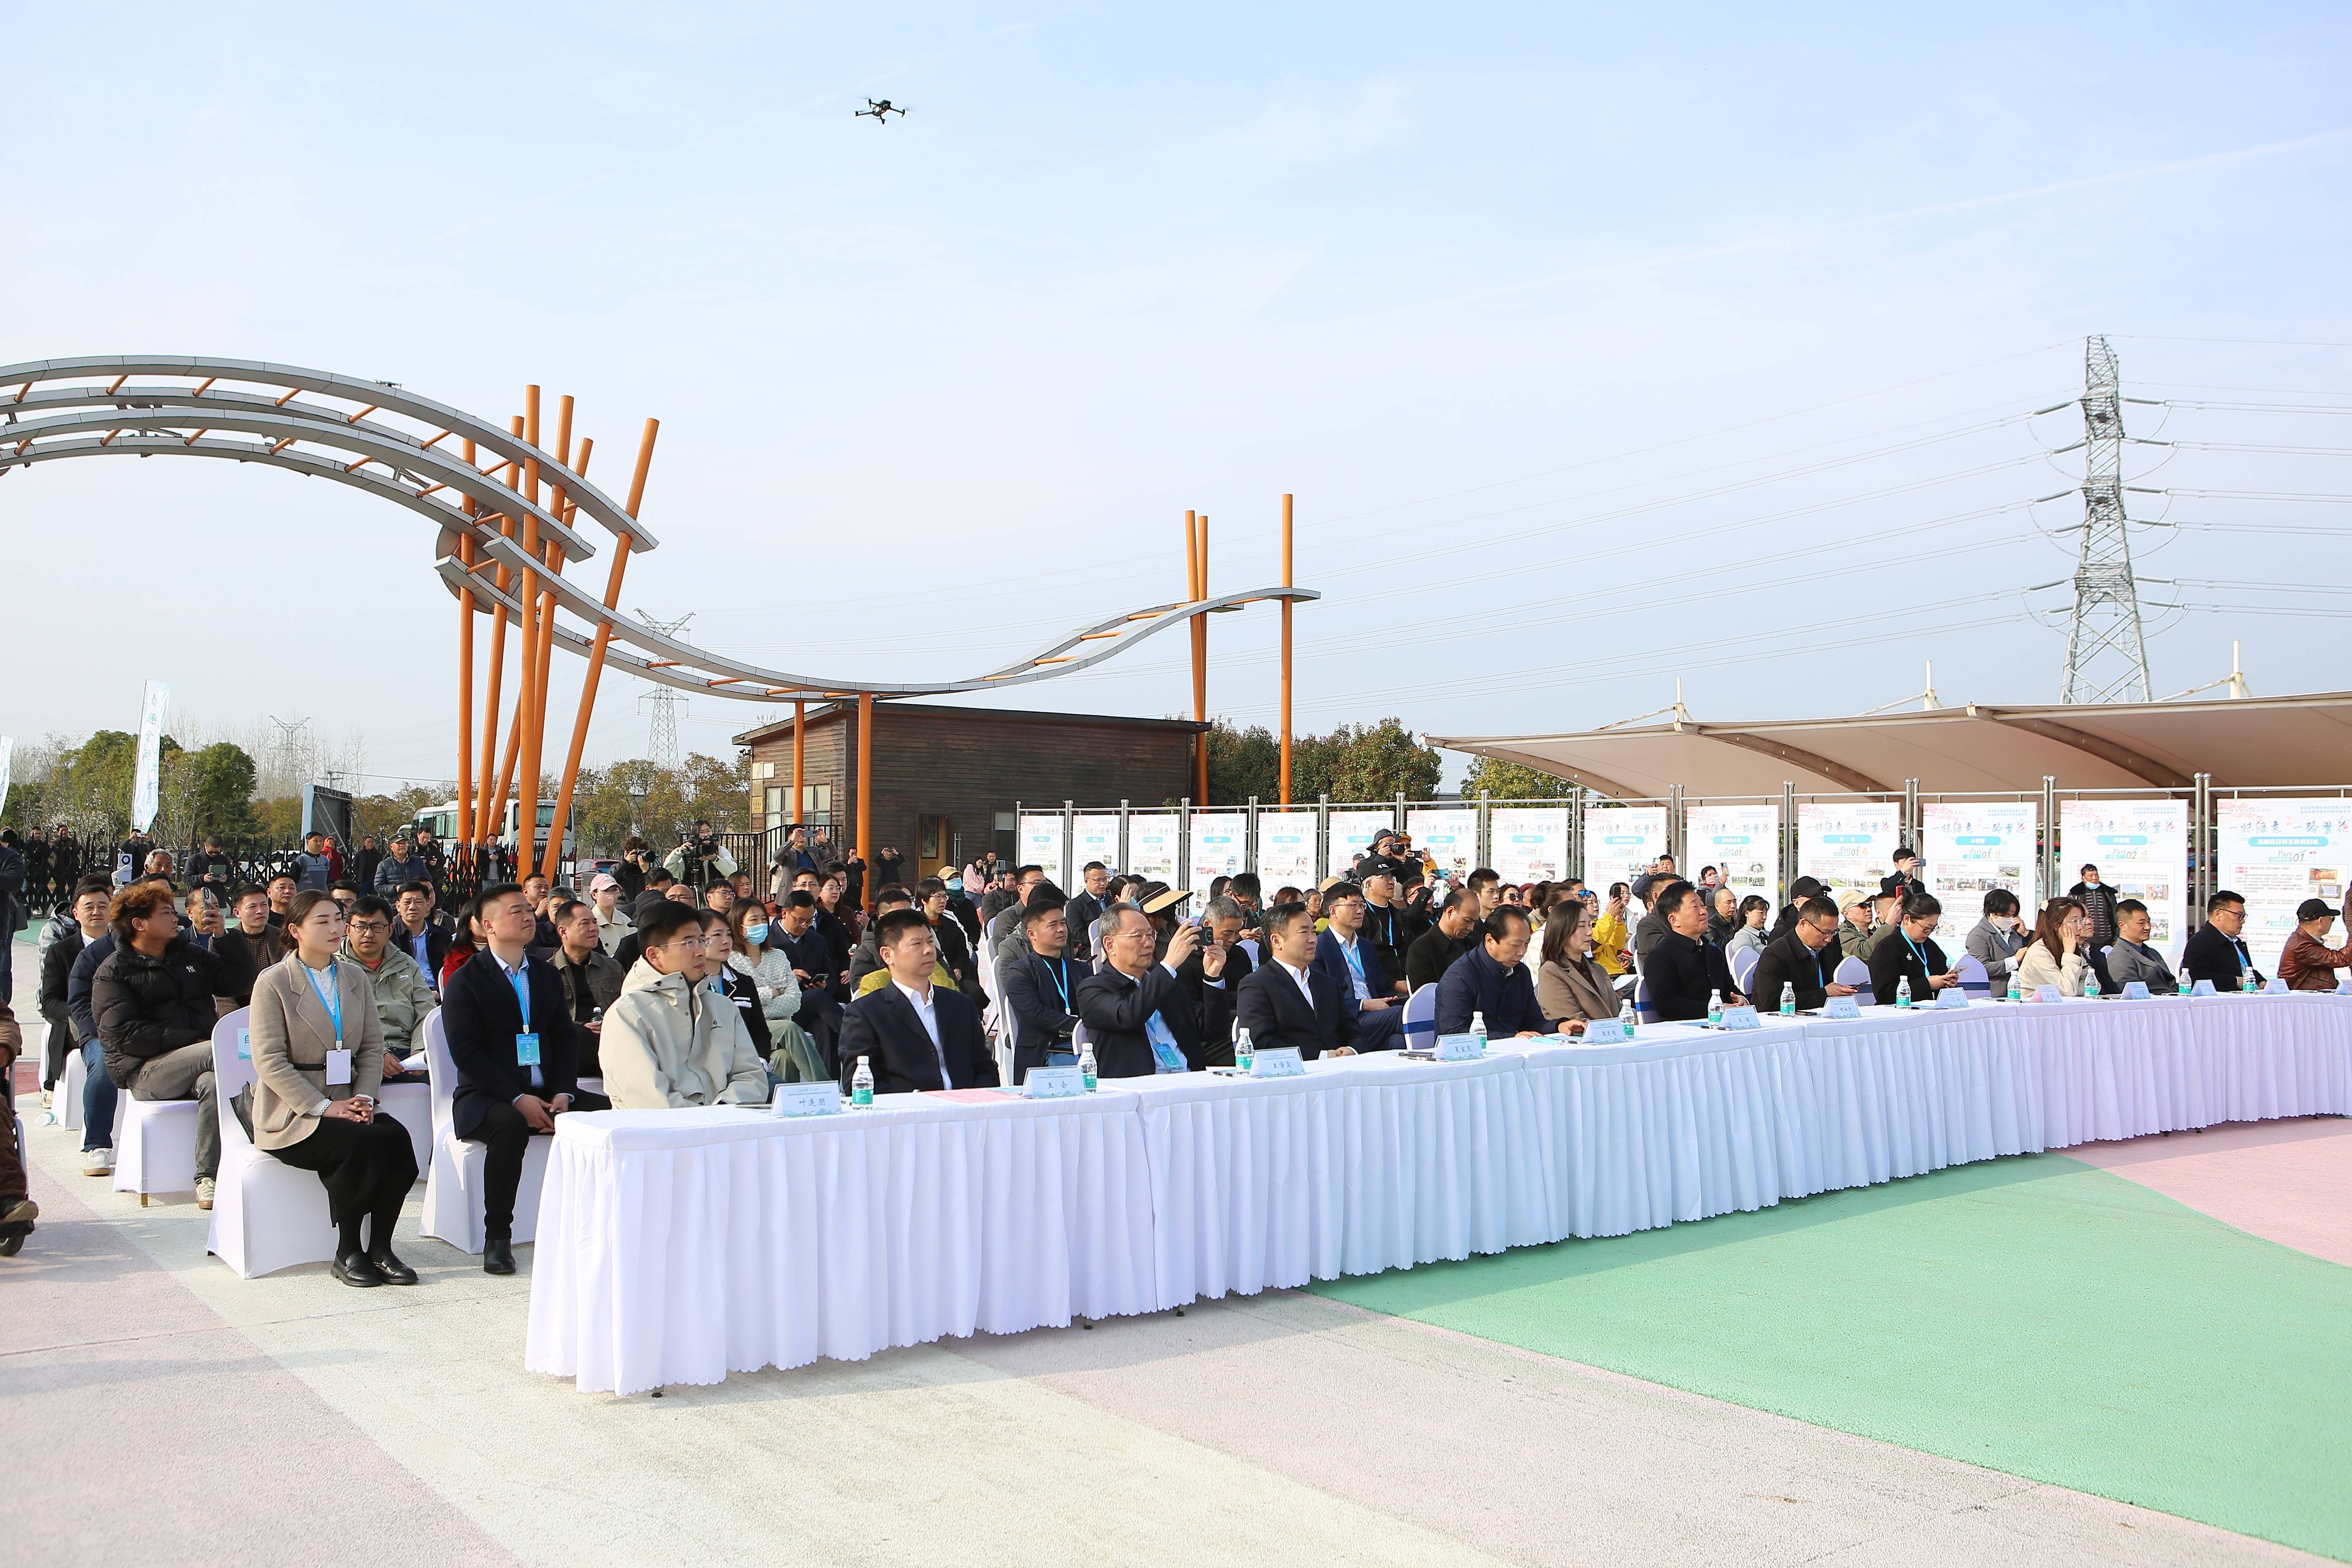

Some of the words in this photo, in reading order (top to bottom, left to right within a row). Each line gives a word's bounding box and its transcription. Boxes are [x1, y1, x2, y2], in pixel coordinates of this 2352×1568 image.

[1982, 851, 1991, 859] 01
[2126, 851, 2137, 860] 02
[2293, 853, 2305, 862] 01
